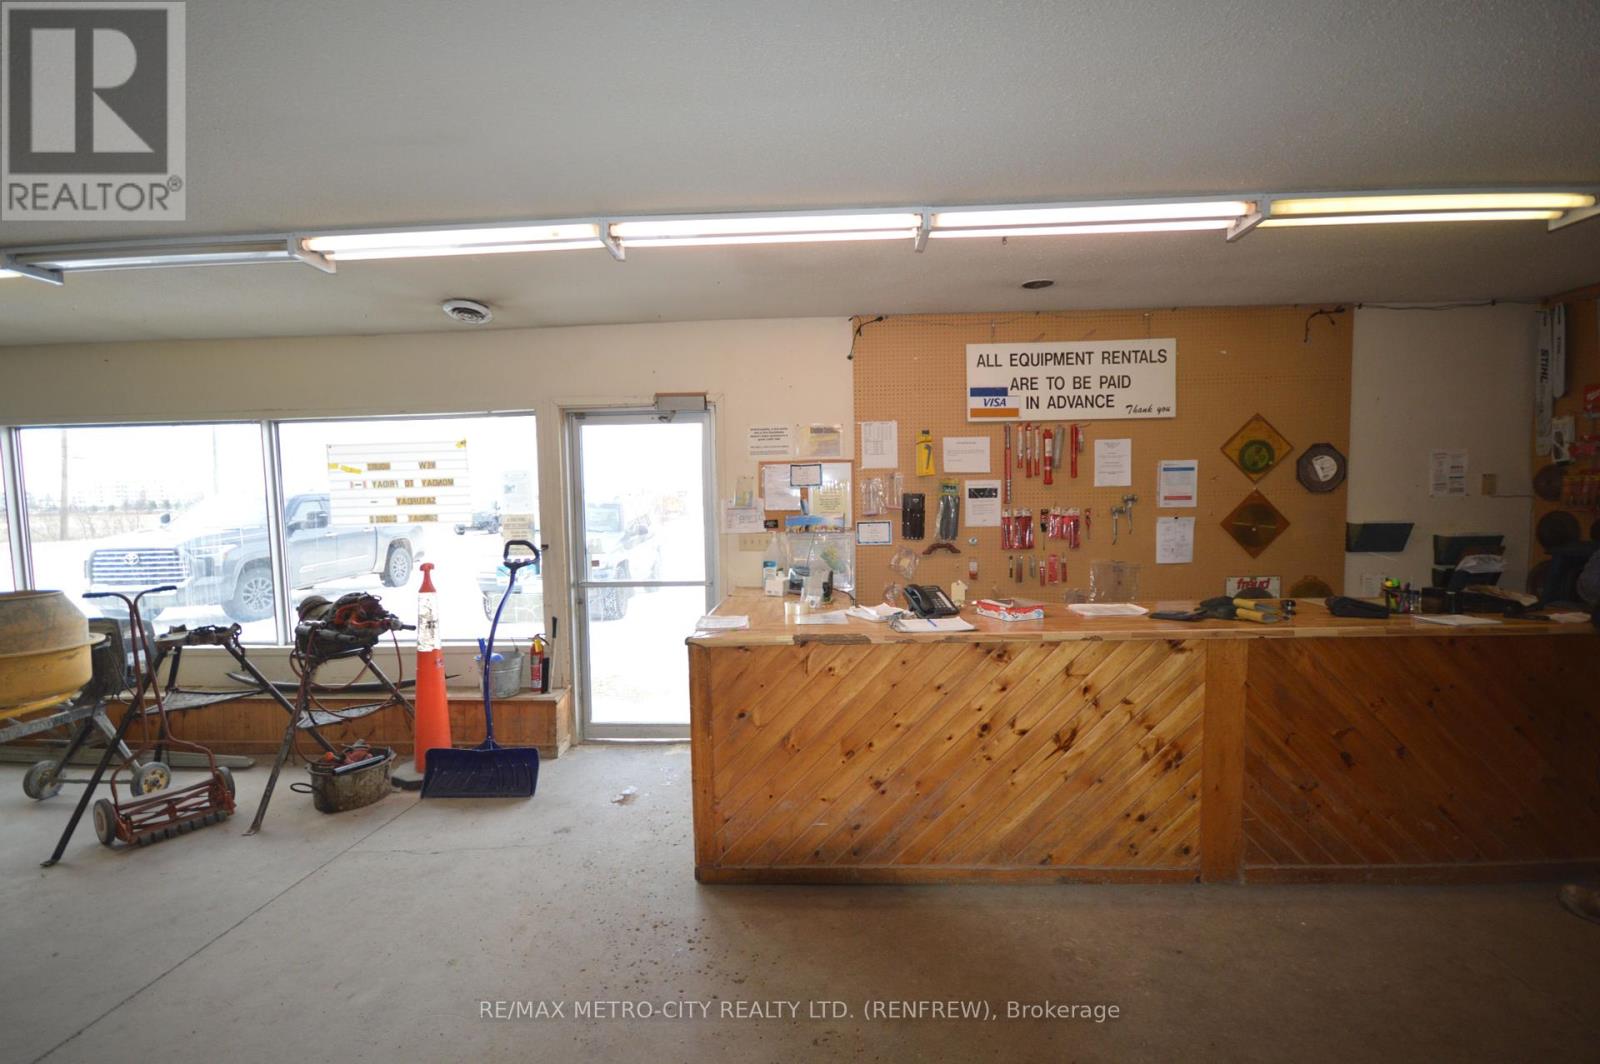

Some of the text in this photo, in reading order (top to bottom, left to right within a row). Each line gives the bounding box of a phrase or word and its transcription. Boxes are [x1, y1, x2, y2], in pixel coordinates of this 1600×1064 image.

[976, 349, 1168, 367] ALL EQUIPMENT RENTALS
[1540, 349, 1550, 384] STIHL
[1010, 374, 1132, 391] ARE TO BE PAID
[982, 397, 1008, 408] VISA
[1025, 394, 1115, 409] IN ADVANCE
[1125, 404, 1171, 415] Thank you
